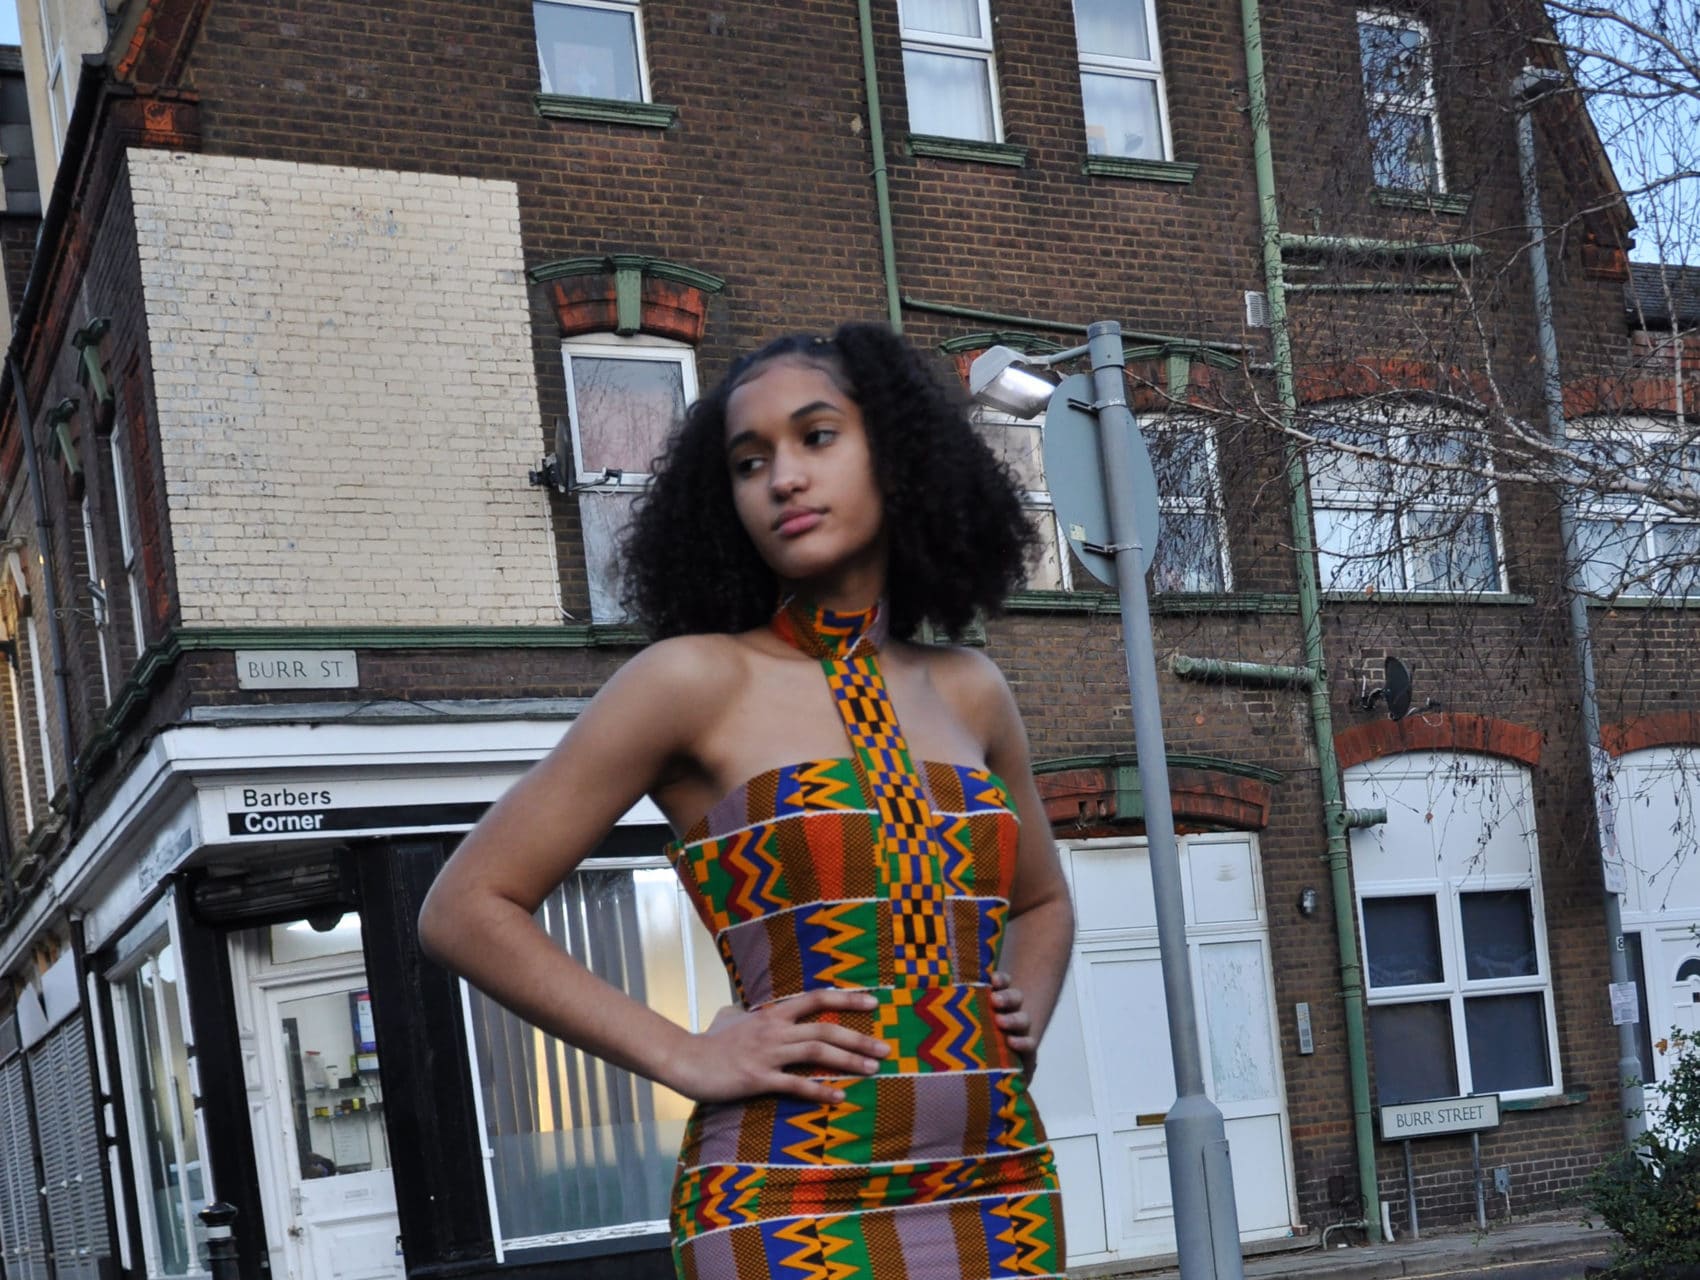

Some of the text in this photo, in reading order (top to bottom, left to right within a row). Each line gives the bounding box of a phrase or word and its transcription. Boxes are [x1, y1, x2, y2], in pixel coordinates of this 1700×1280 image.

[248, 660, 343, 679] BURR ST
[243, 788, 332, 807] Barbers
[244, 812, 324, 832] Corner
[1396, 1105, 1485, 1128] BURR STREET
